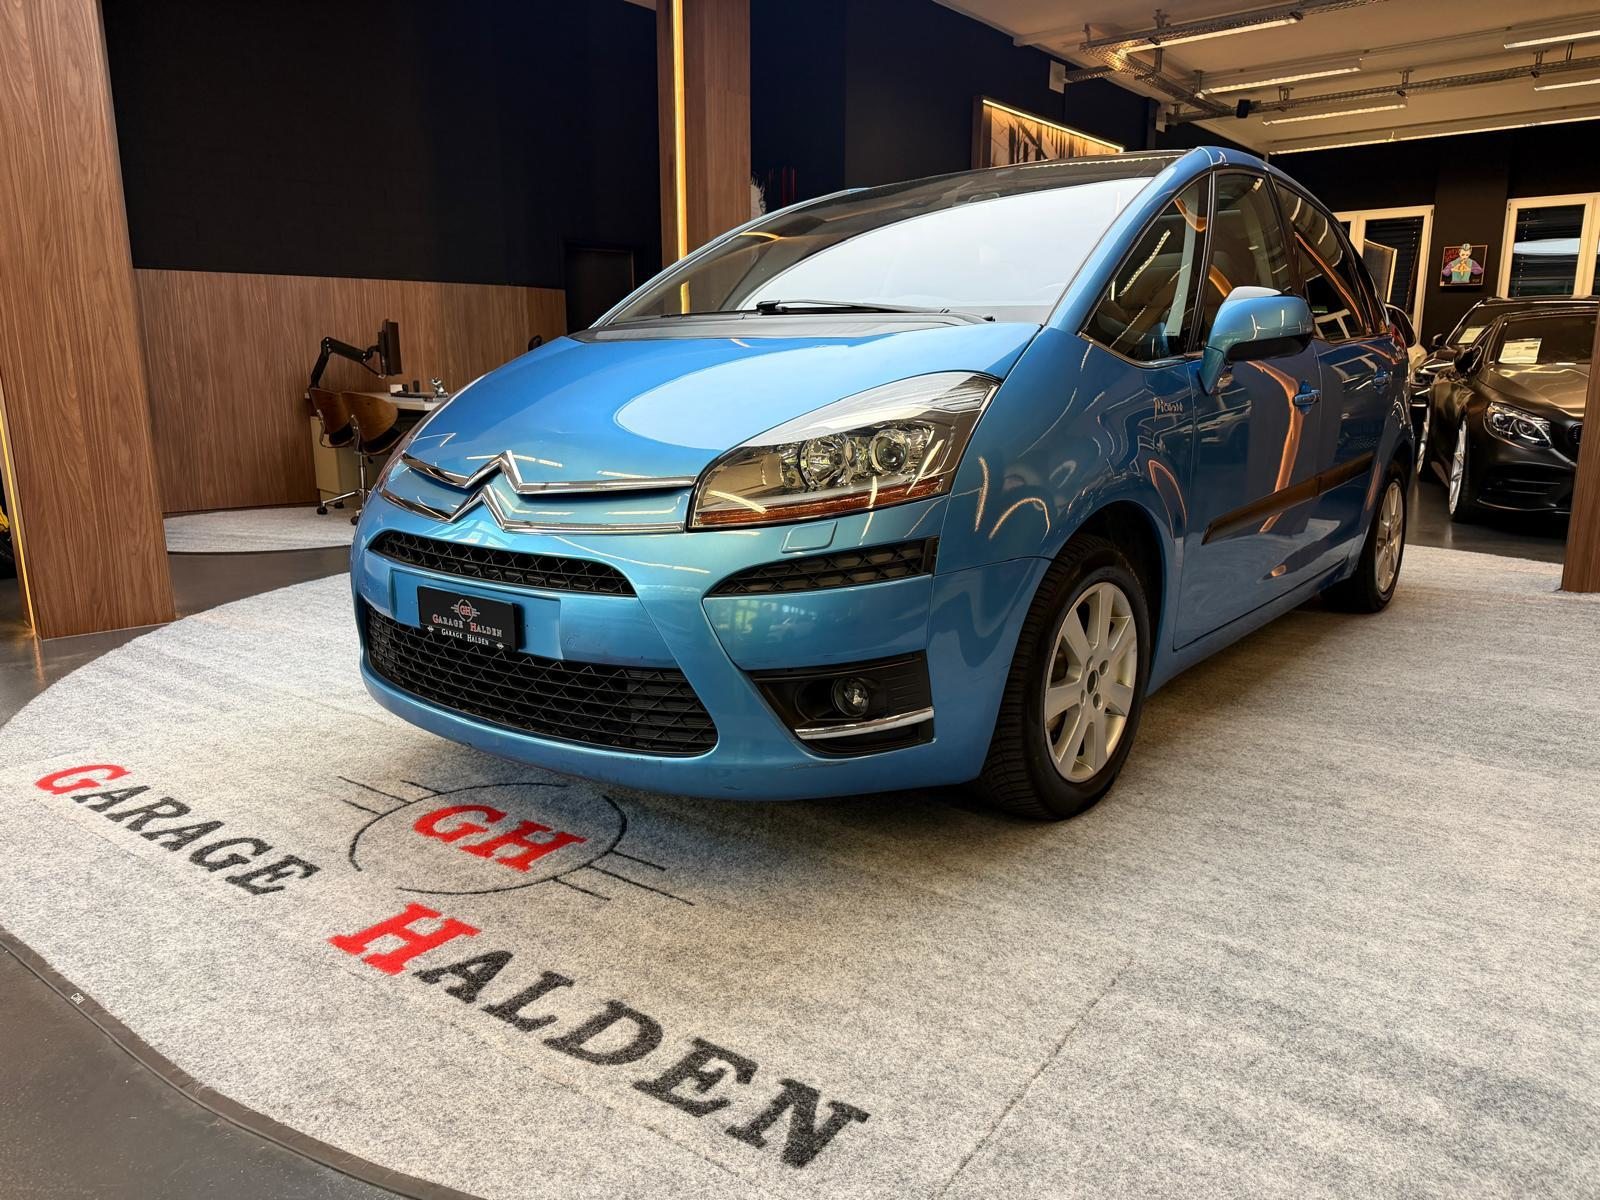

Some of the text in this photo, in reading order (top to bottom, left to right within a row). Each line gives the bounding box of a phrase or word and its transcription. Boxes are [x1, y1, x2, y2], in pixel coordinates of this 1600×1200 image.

[432, 613, 502, 638] GARAGE HALDEN
[441, 628, 489, 646] GARAGE HALDEN
[35, 763, 321, 896] GARAGE
[412, 803, 588, 873] GH
[327, 901, 870, 1170] HALDEN
